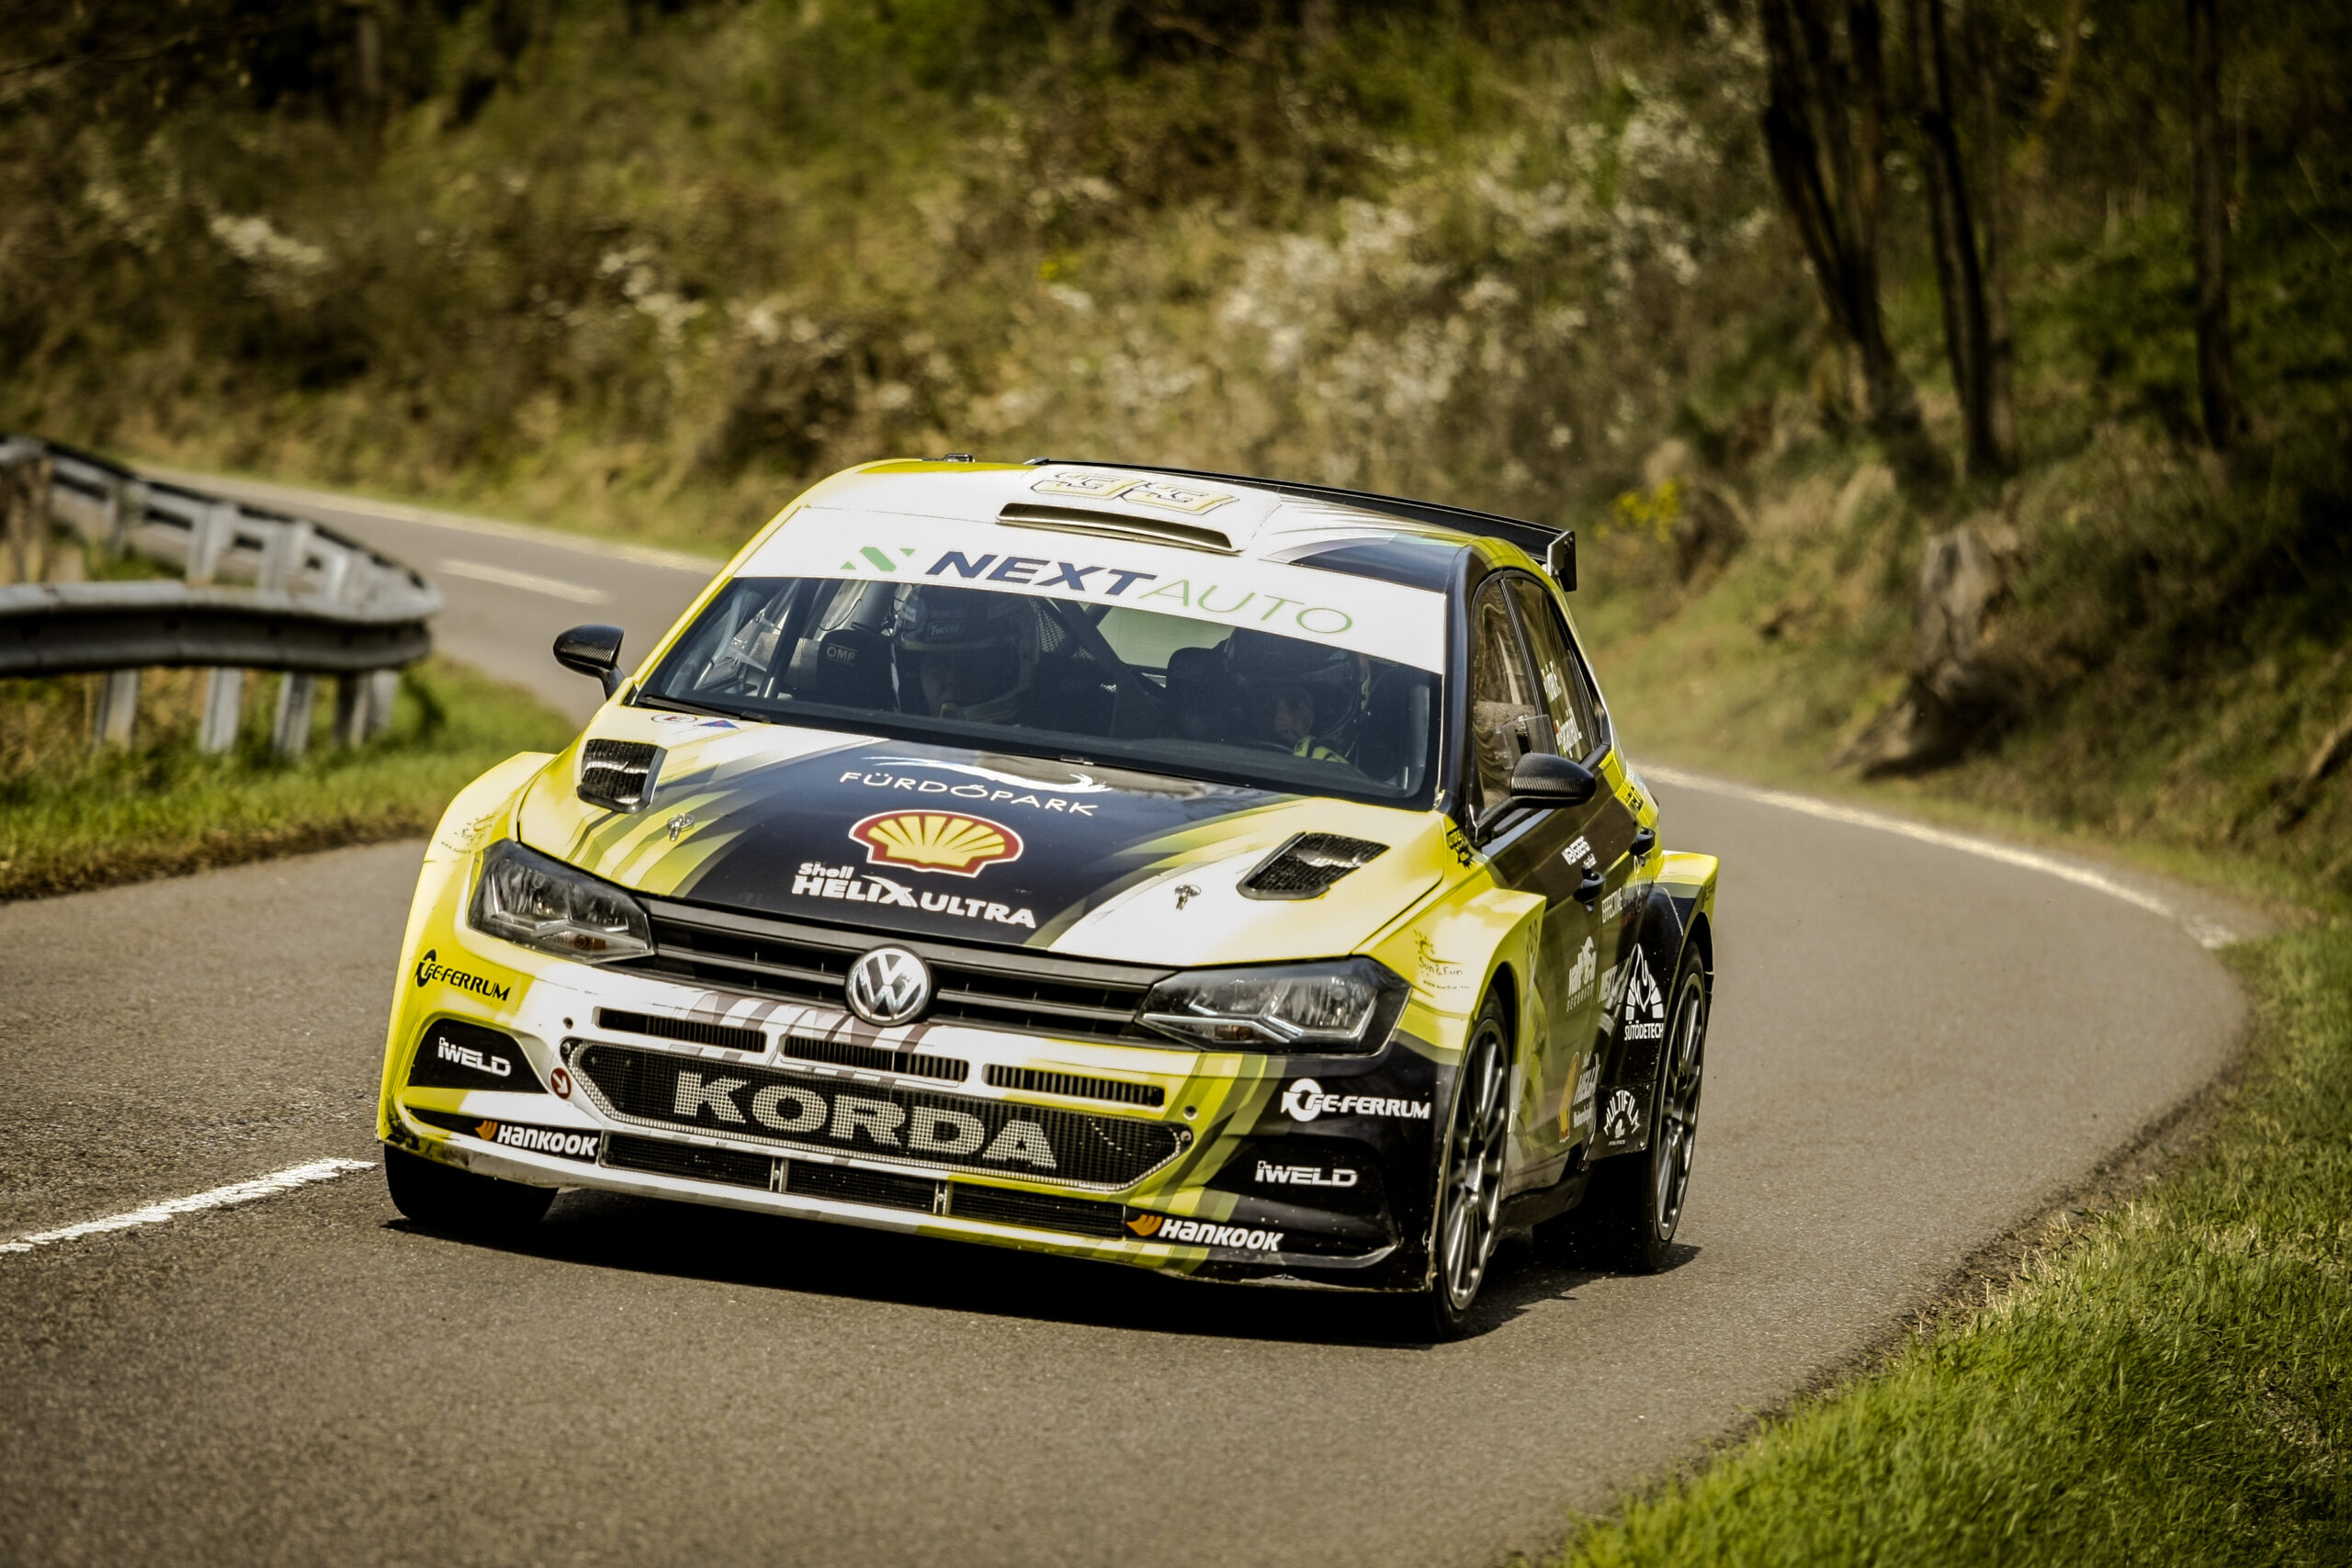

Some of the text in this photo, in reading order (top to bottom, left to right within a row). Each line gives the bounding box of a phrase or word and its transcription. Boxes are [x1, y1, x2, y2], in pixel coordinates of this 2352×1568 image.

[839, 772, 1099, 817] FÜRDŐPARK
[797, 862, 854, 880] Shell
[437, 1036, 512, 1077] iWELD
[673, 1069, 1057, 1169] KORDA
[1254, 1160, 1358, 1188] iWELD
